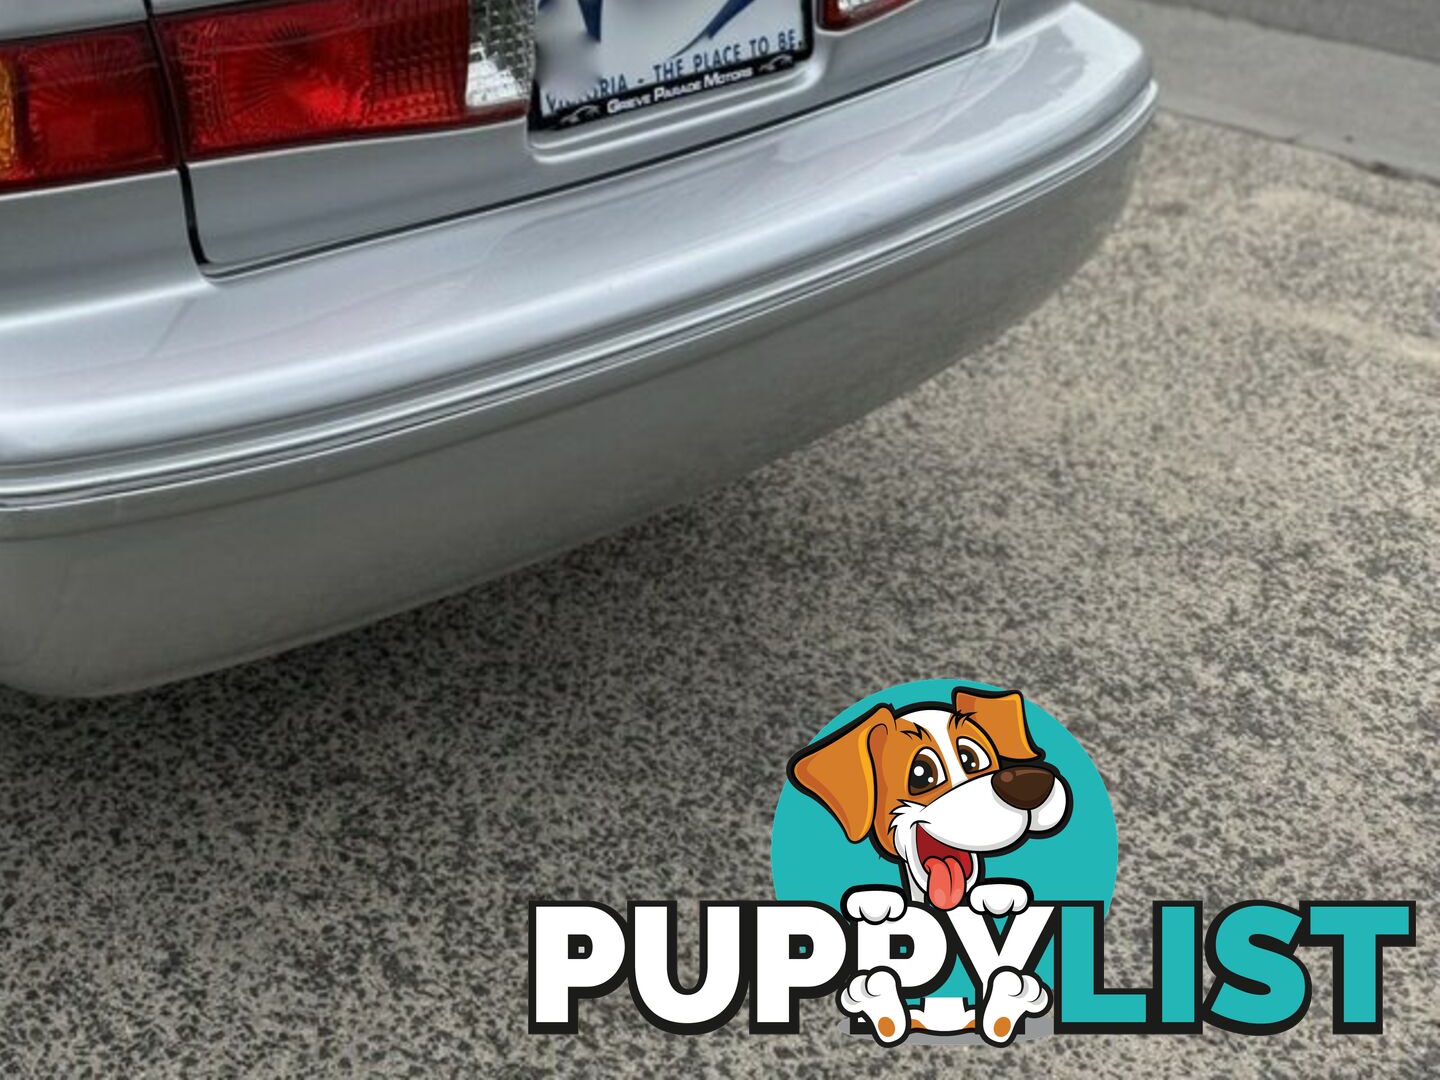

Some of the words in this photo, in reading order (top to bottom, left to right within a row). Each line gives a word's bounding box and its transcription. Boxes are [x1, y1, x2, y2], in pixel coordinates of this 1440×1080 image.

[653, 58, 684, 82] THE
[693, 44, 741, 70] PLACE
[749, 38, 769, 58] TO
